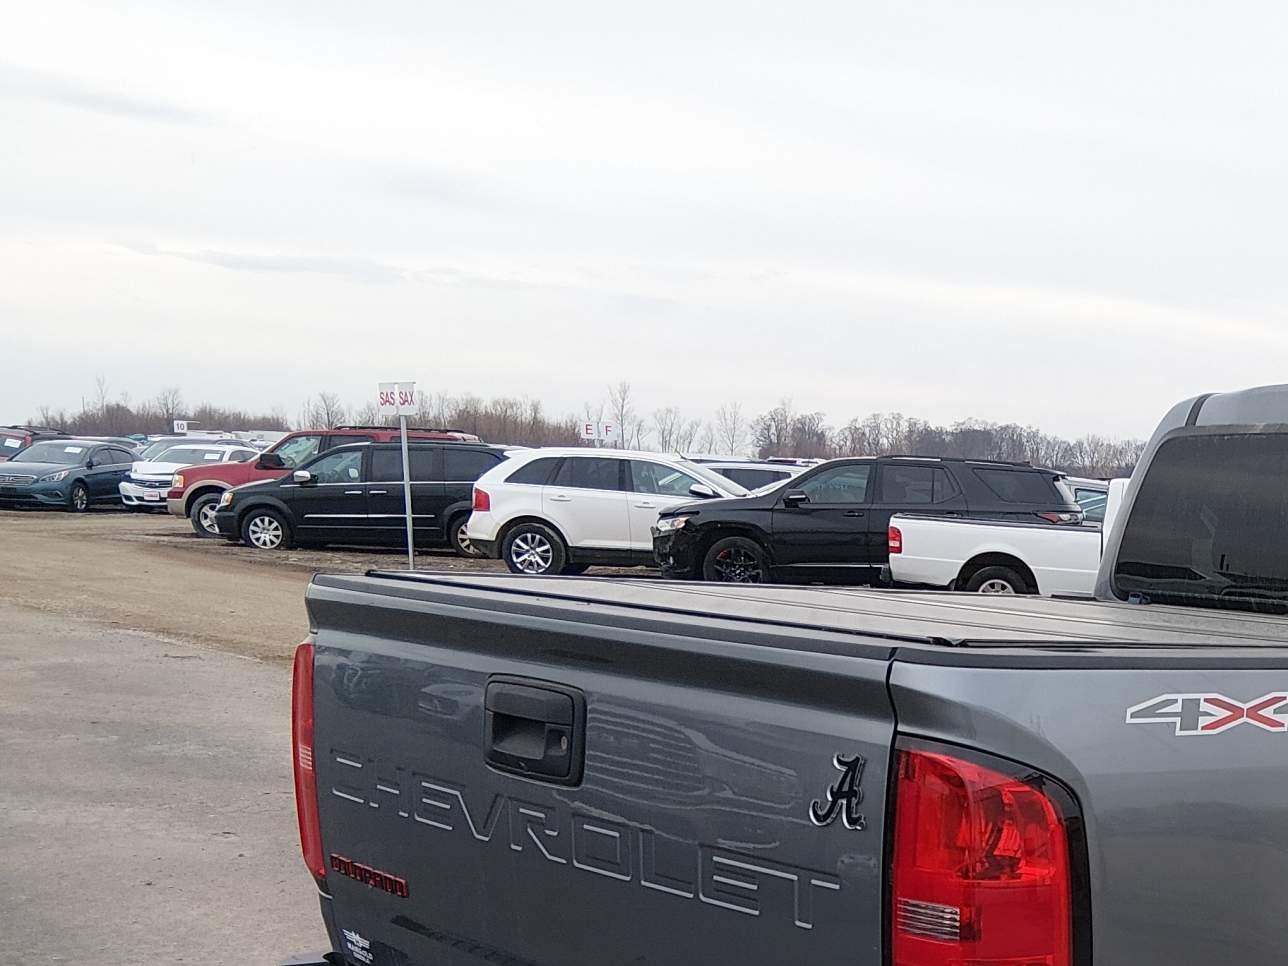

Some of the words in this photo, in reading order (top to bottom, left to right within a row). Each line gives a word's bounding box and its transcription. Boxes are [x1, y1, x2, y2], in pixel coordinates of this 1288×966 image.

[380, 391, 395, 406] SAS
[399, 391, 415, 406] SAX
[176, 423, 185, 431] 10
[585, 424, 594, 435] E
[605, 425, 612, 436] F
[330, 748, 841, 929] CHEVROLET
